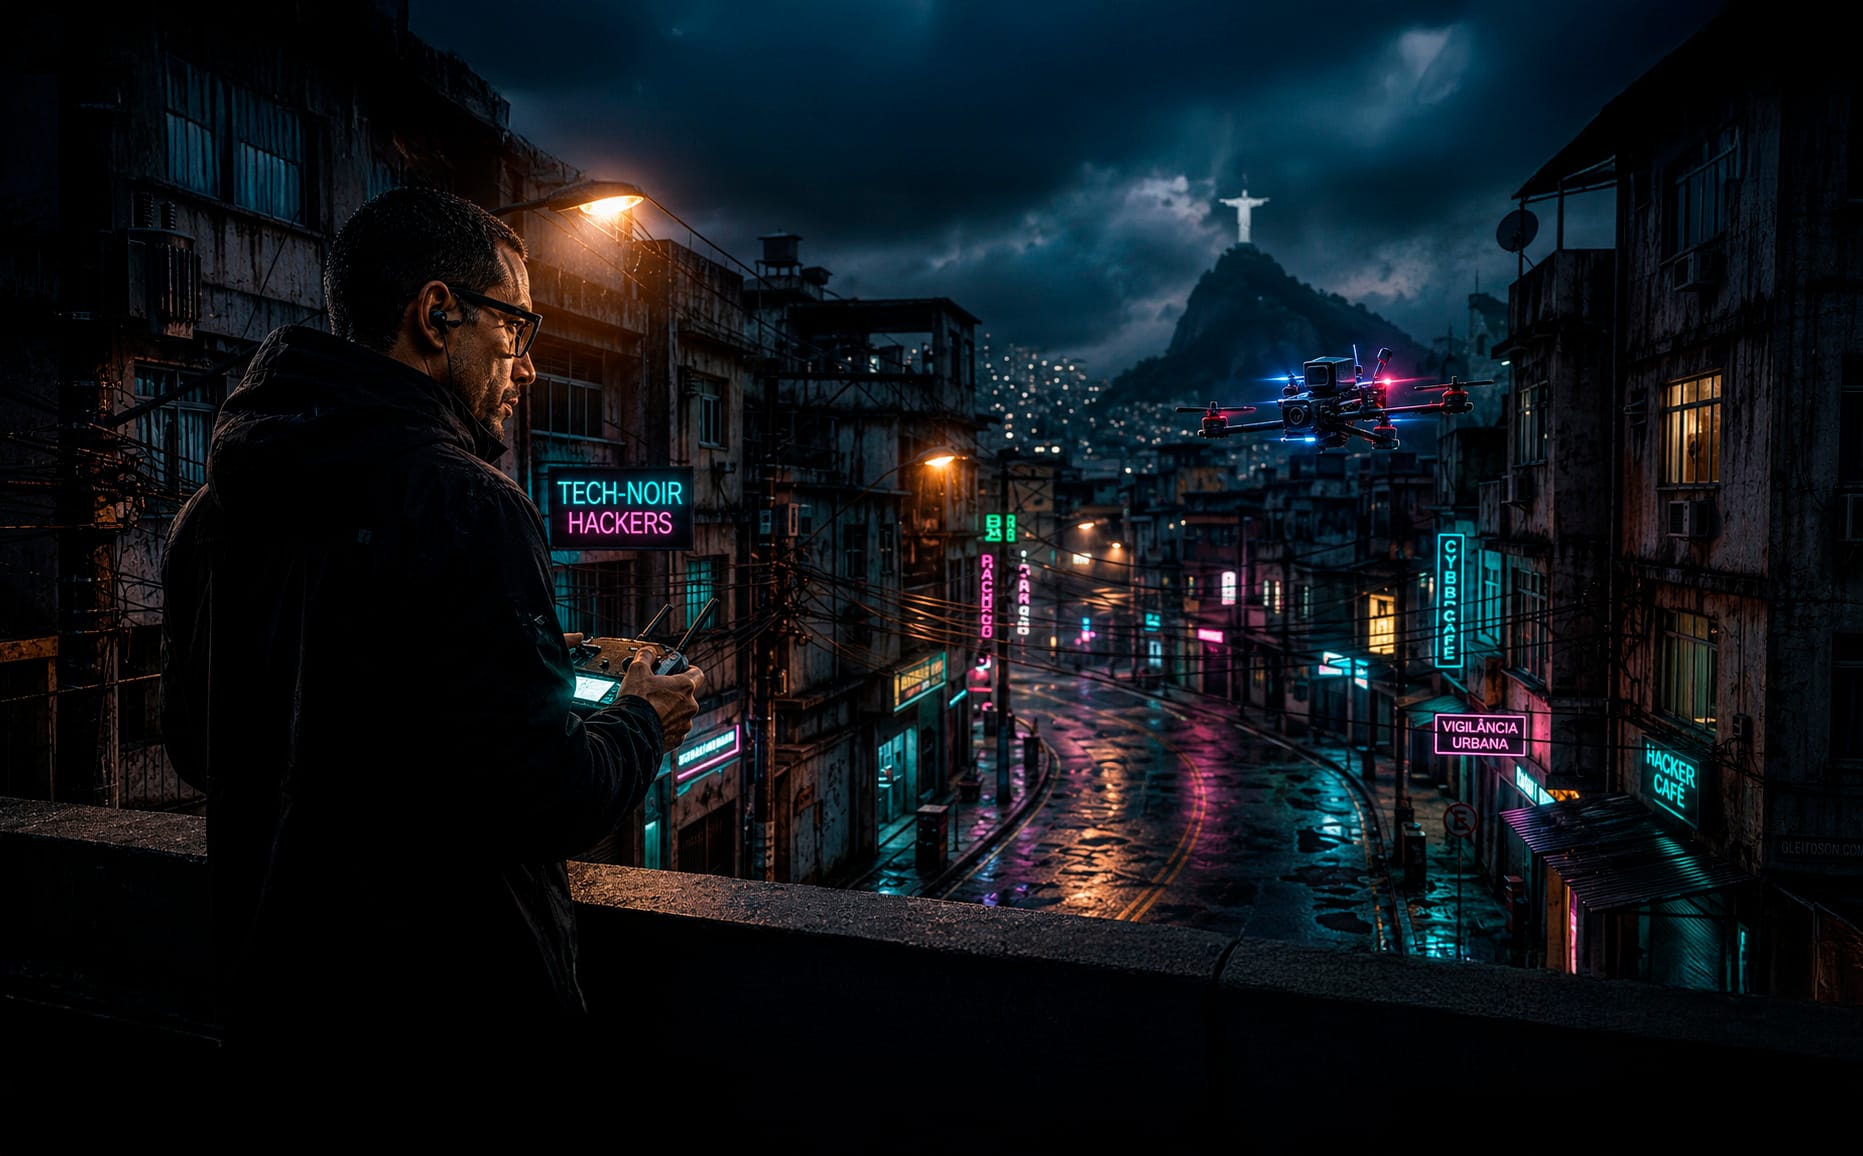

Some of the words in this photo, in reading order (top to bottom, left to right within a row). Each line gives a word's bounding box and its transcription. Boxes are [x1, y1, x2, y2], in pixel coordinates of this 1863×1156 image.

[557, 481, 683, 505] TECH-NOIR
[568, 511, 673, 534] HACKERS
[1442, 718, 1519, 734] VIGILÂNCIA
[1452, 736, 1509, 750] URBANA
[1646, 743, 1695, 788] HACKER
[1654, 774, 1685, 809] CAFÉ
